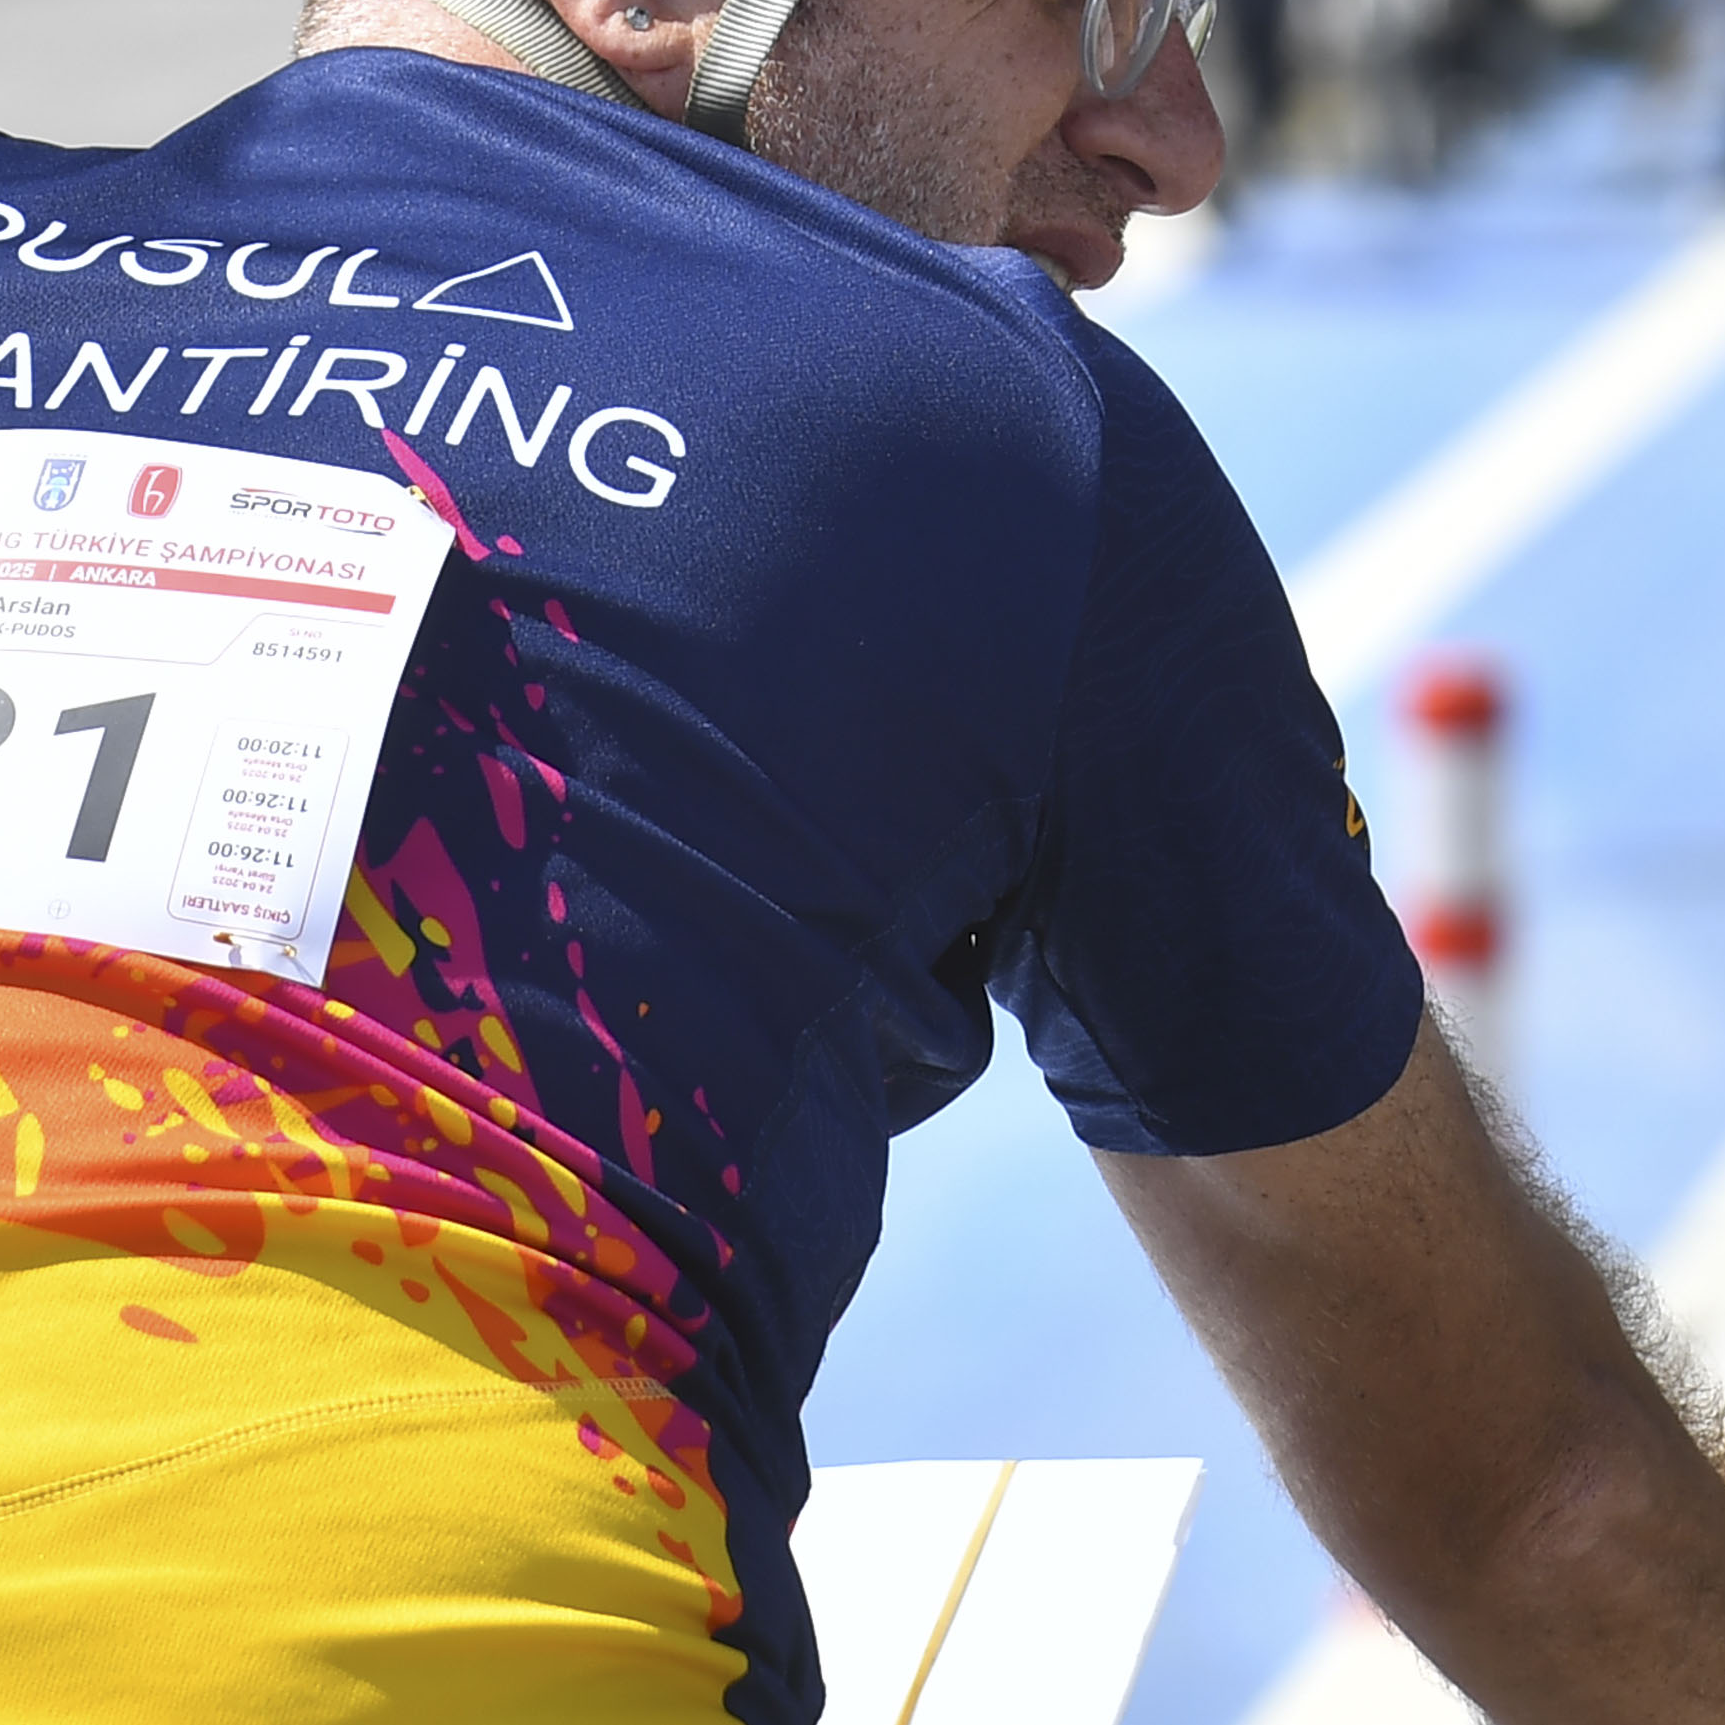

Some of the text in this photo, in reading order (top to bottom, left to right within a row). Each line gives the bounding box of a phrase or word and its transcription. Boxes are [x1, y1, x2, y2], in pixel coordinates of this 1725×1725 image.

[34, 528, 153, 558] TÜRKİYE
[159, 541, 366, 582] ŞAMPİYONASI
[68, 565, 157, 587] ANKARA
[251, 641, 344, 663] 8514591
[237, 736, 323, 760] 11:20:00
[222, 788, 309, 813] 11:26:00
[207, 840, 295, 869] 11:26:00
